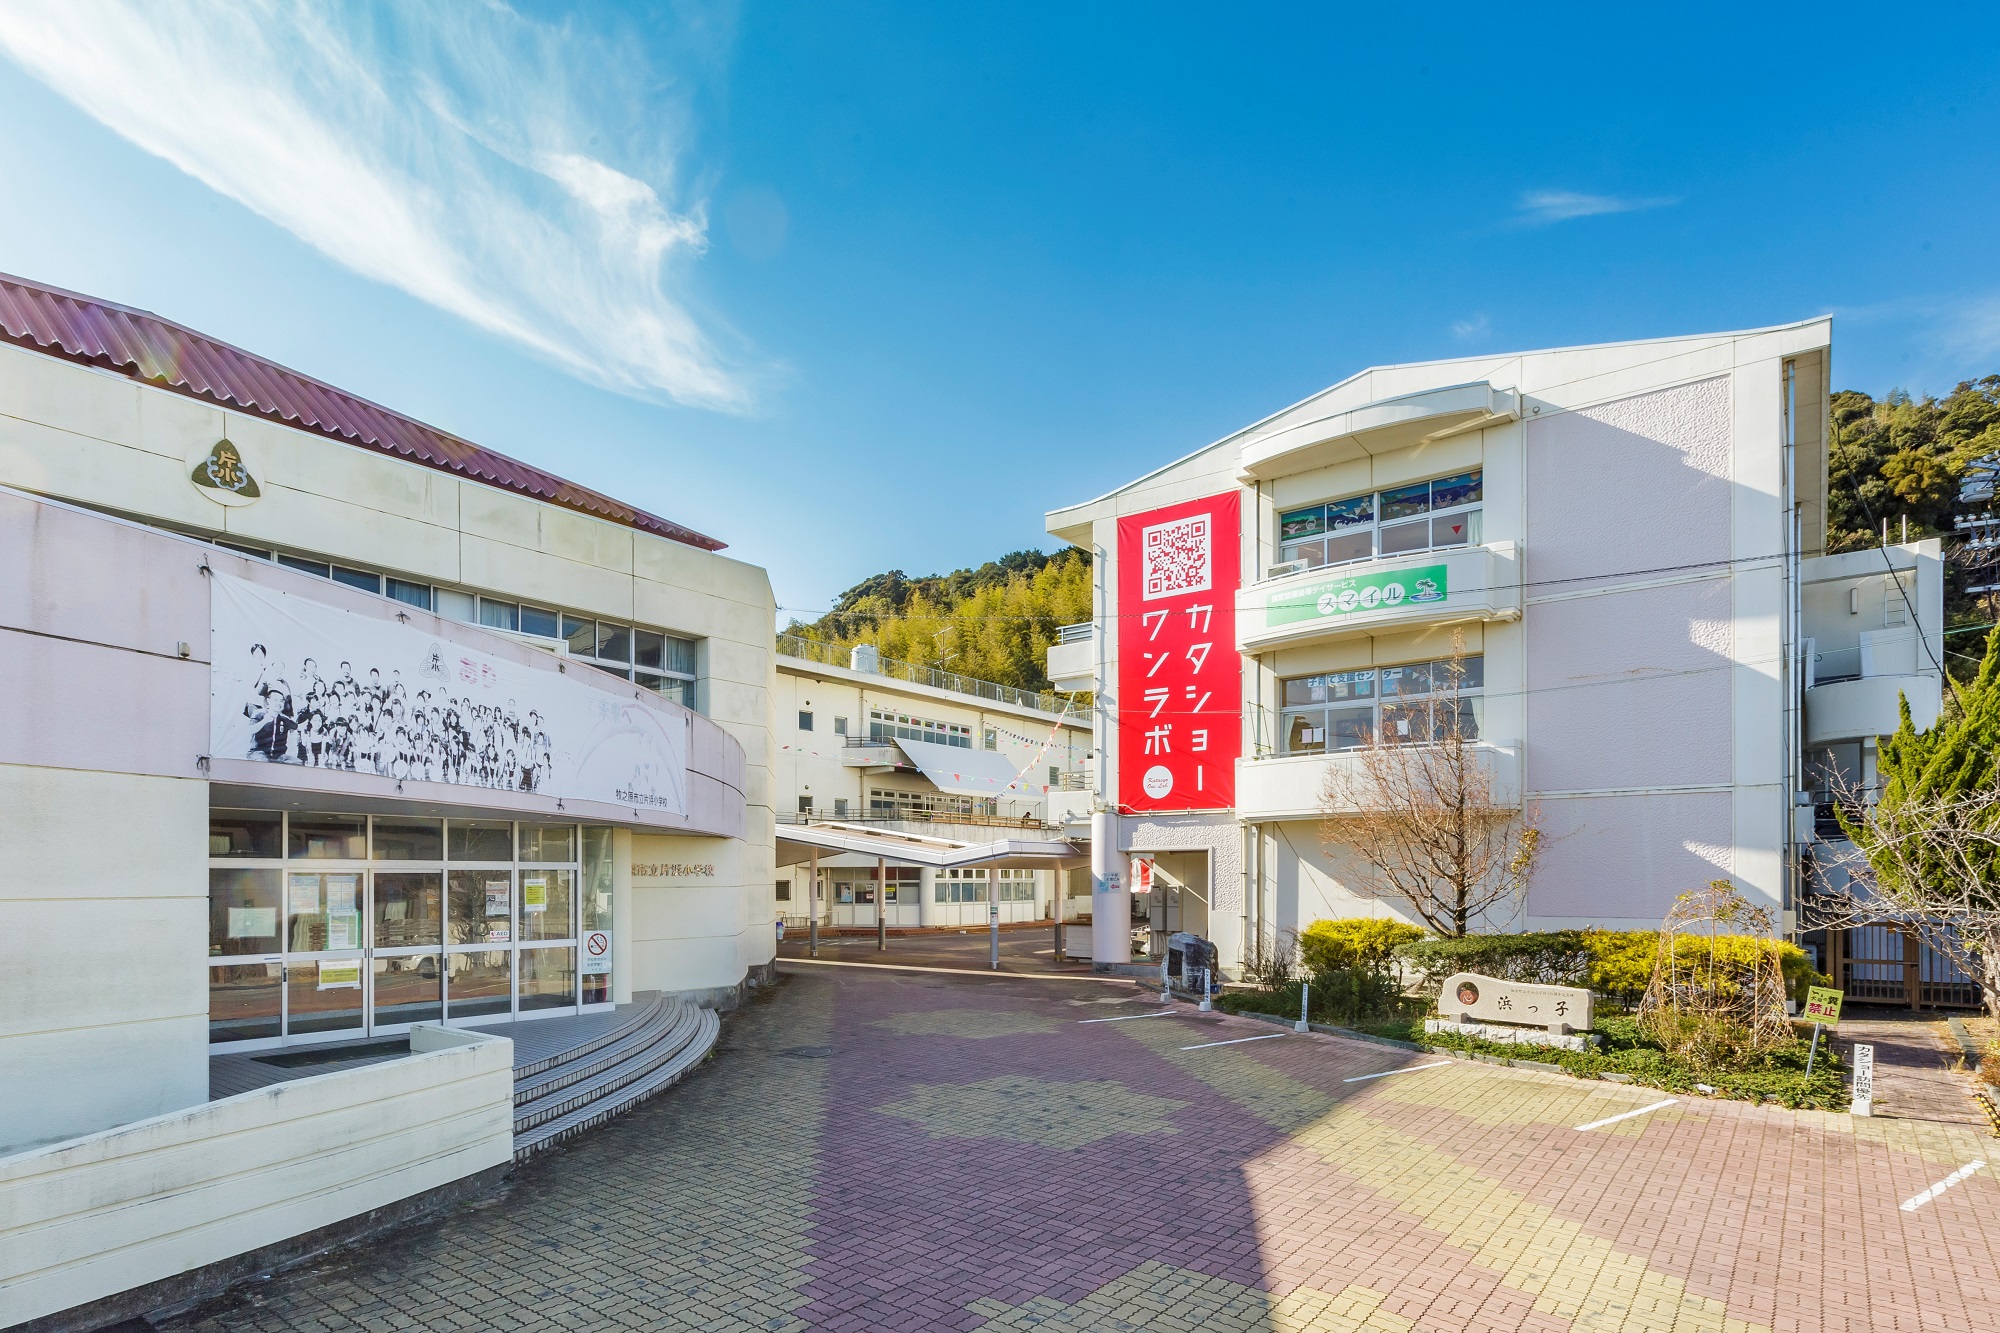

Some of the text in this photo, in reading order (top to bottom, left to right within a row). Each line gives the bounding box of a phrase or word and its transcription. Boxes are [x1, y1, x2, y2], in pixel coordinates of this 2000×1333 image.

[1320, 587, 1402, 611] スマイル
[1143, 608, 1172, 756] ワンラボ
[1308, 669, 1402, 687] 子育て支援センター
[1186, 603, 1213, 791] カタショー
[615, 788, 668, 808] 牧之原市立片浜小学校
[1497, 995, 1570, 1017] 浜っ子
[1808, 1002, 1837, 1018] 禁止
